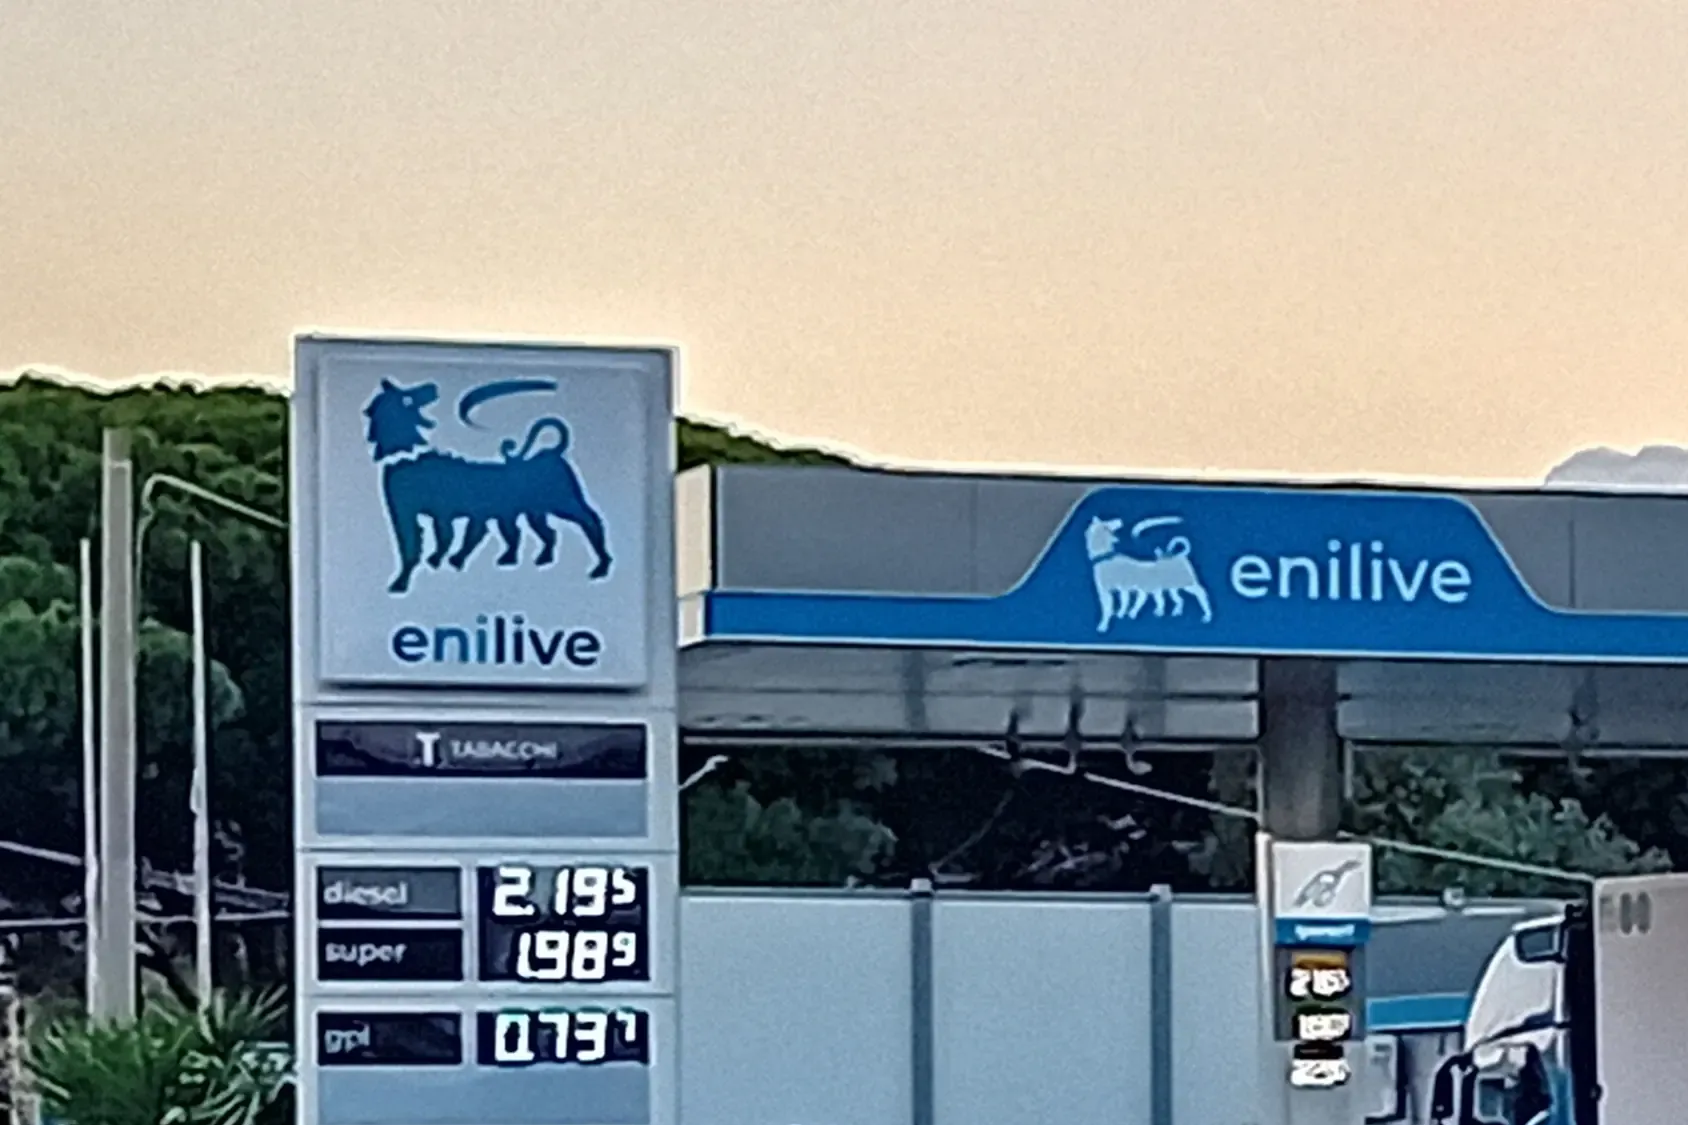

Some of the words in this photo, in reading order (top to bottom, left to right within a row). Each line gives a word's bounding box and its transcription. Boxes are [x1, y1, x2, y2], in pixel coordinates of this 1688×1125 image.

[1230, 539, 1472, 603] enilive
[392, 614, 600, 666] enilive
[323, 879, 408, 905] diesel
[324, 942, 407, 967] super
[324, 1021, 370, 1054] gpl
